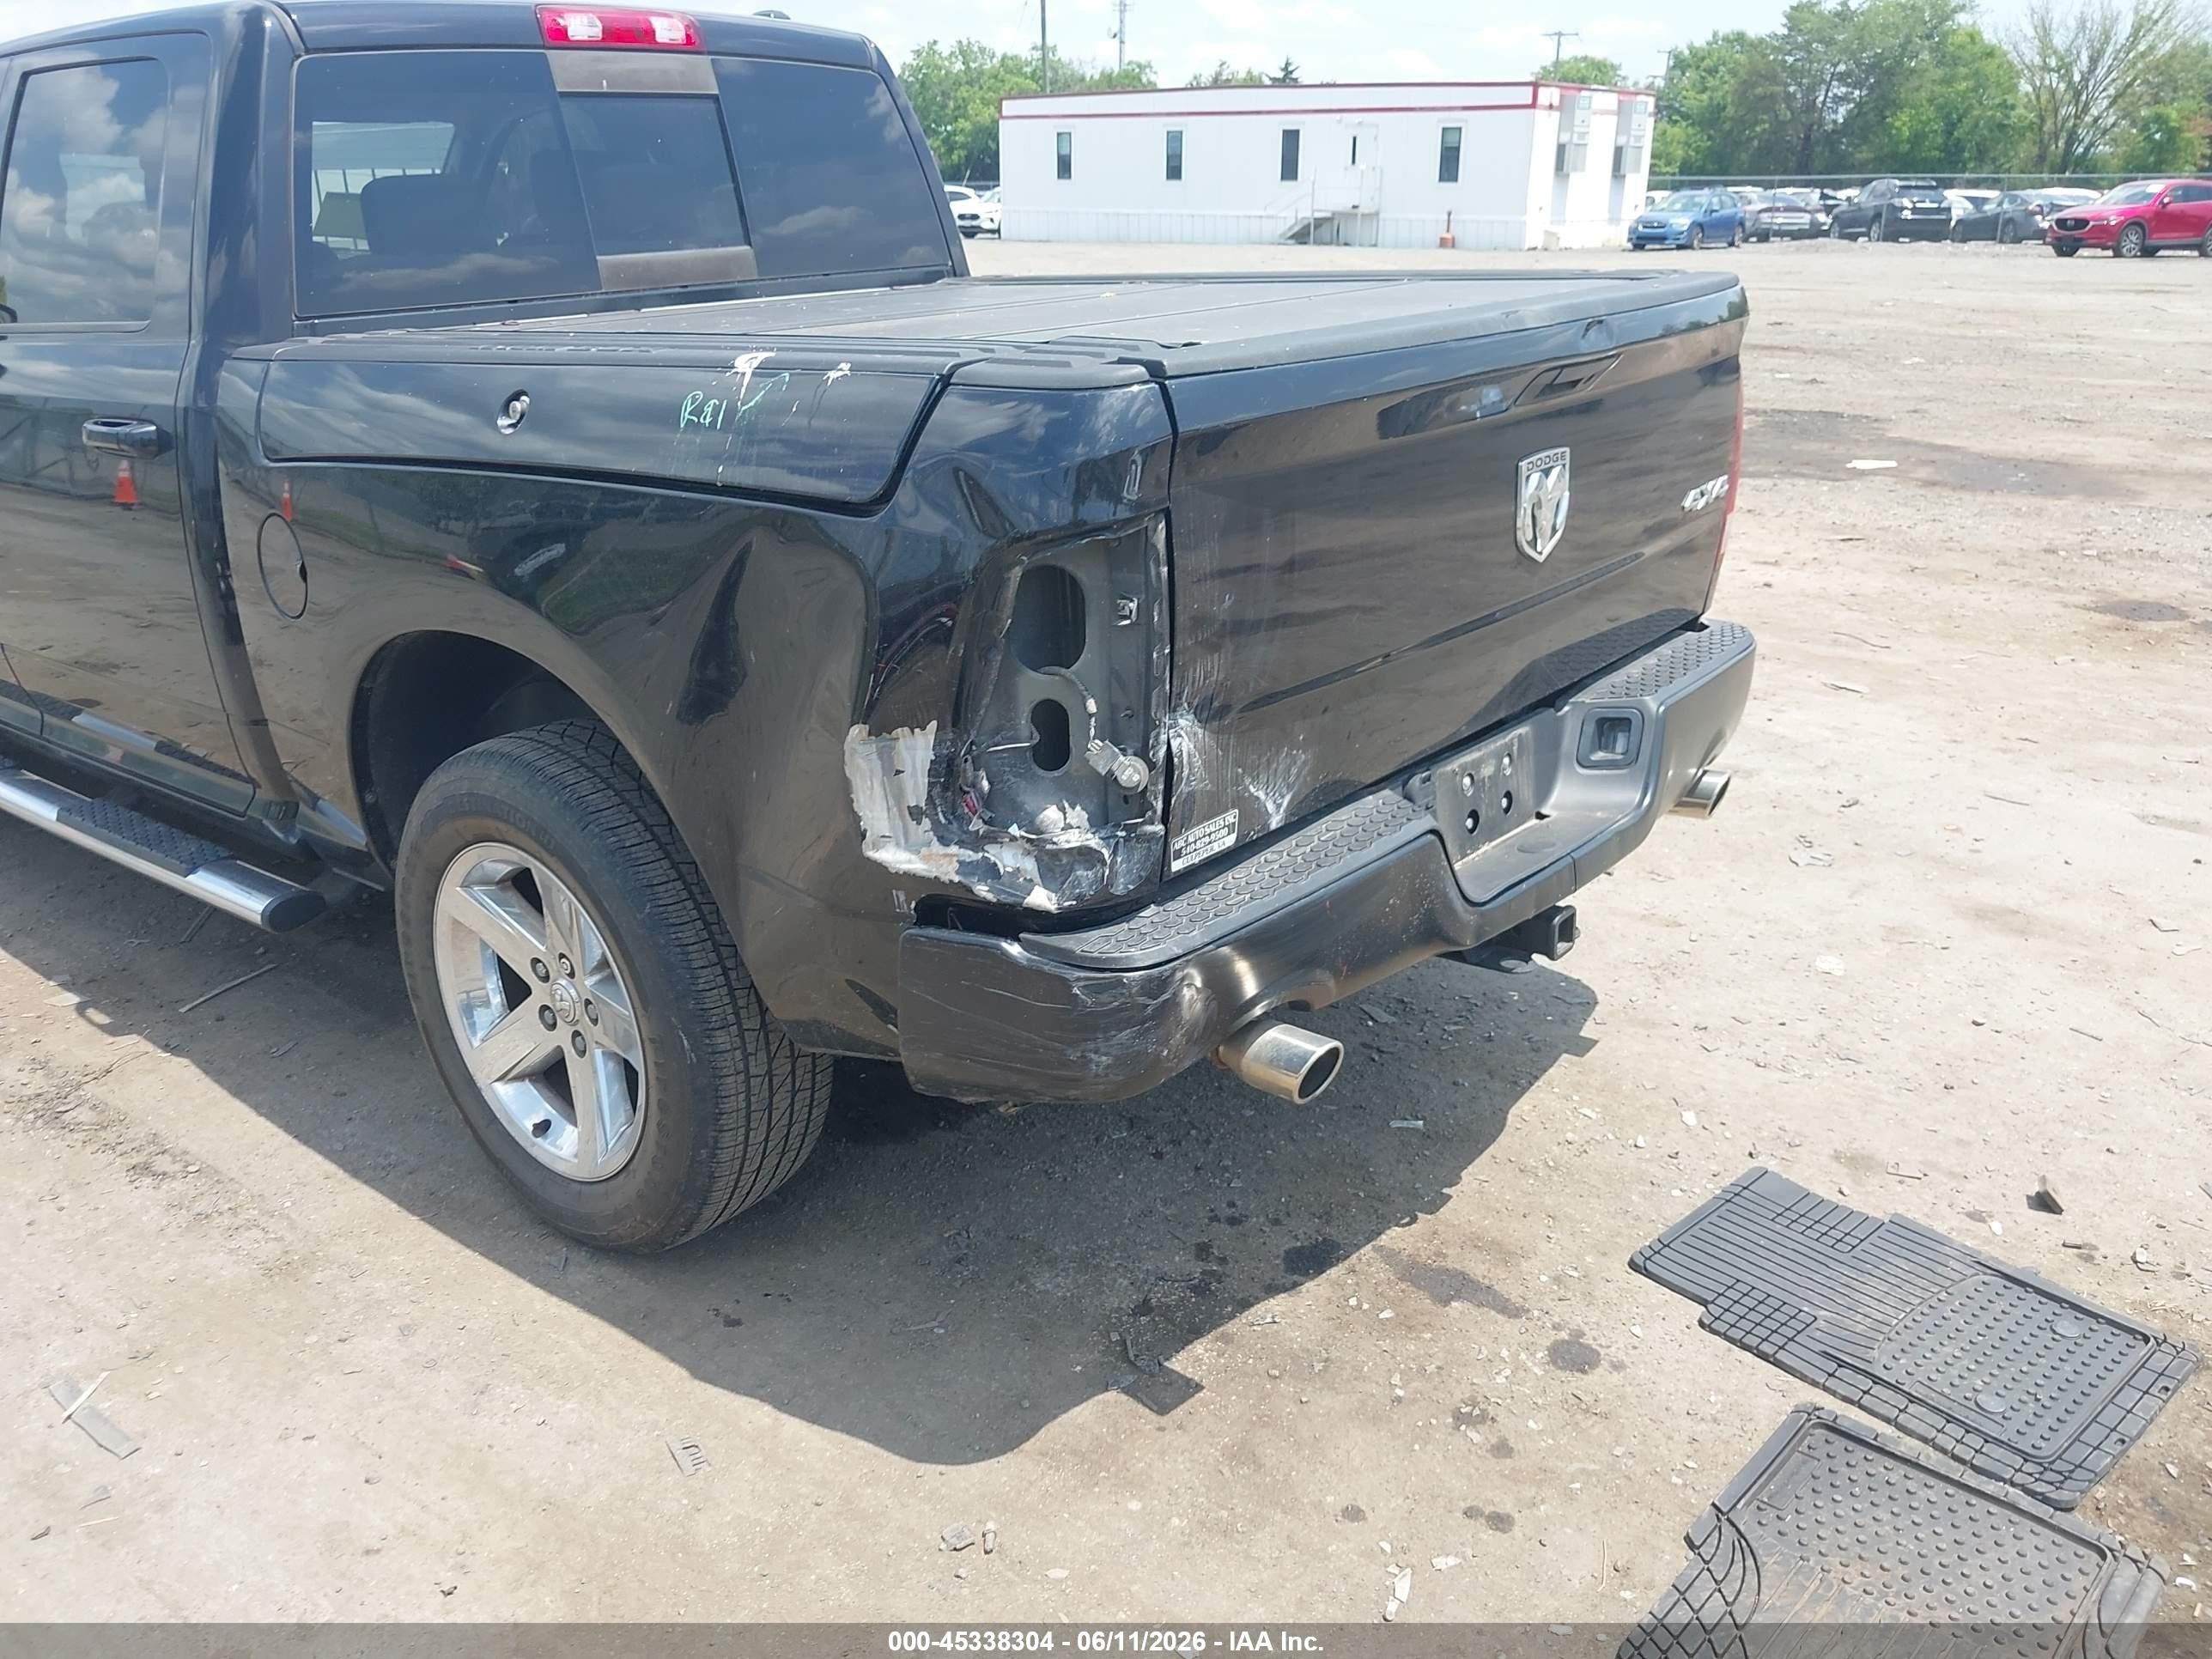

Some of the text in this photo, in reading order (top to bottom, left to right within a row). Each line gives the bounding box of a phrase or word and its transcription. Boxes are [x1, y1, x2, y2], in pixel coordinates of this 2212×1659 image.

[1527, 451, 1567, 470] DODGE
[1173, 837, 1187, 851] ABC
[1187, 828, 1204, 843] AUTO
[1204, 818, 1224, 836] SALES
